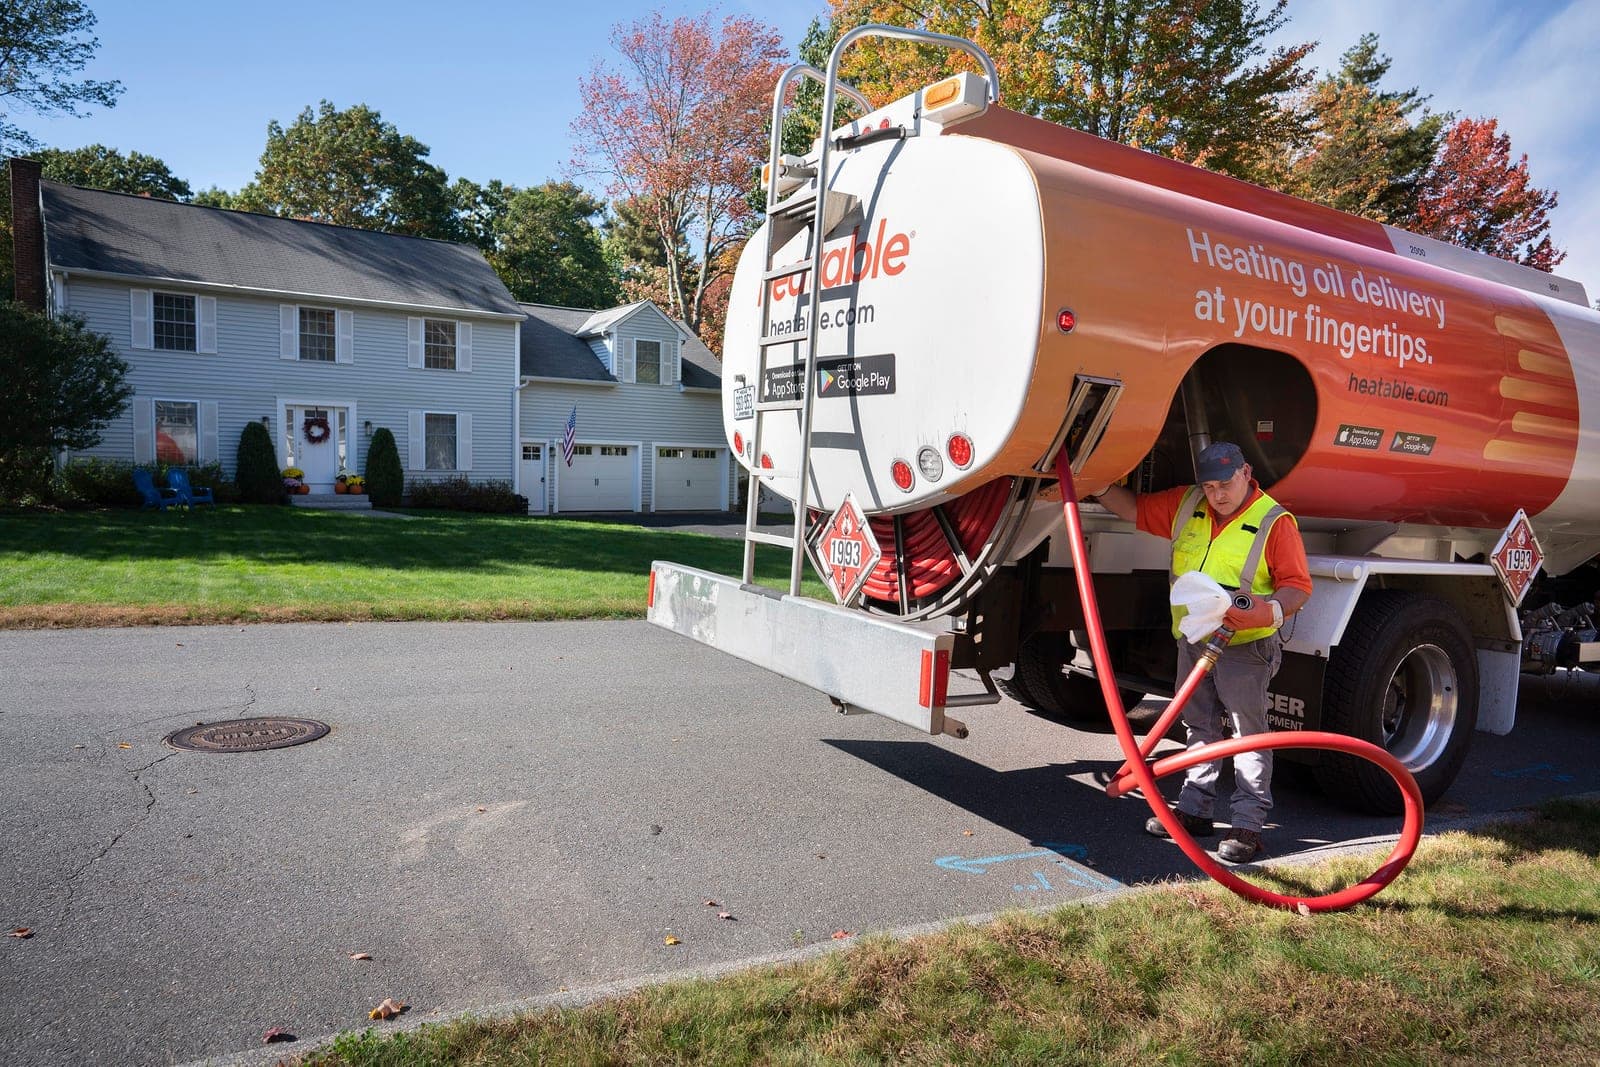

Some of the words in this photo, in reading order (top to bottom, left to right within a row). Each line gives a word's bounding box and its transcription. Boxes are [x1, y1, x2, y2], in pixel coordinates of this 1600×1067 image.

[1409, 245, 1426, 257] 2000
[757, 218, 910, 307] eaable
[1187, 228, 1307, 297] Heating
[1313, 263, 1345, 298] oil
[1351, 270, 1445, 329] delivery
[769, 303, 876, 337] heatae.com
[1195, 287, 1225, 324] at
[1233, 296, 1298, 338] your
[1304, 305, 1433, 368] fingertips.
[771, 370, 791, 380] Download
[853, 362, 862, 370] ON
[772, 382, 786, 399] App
[786, 379, 806, 395] Store
[837, 374, 869, 391] Google
[870, 371, 891, 389] Play
[1348, 372, 1449, 408] heatable.com
[1348, 435, 1361, 446] App
[1360, 436, 1378, 447] Store
[1403, 441, 1421, 452] Google
[1420, 445, 1432, 454] Play
[831, 541, 861, 567] 1993
[1507, 550, 1531, 569] 1993
[1265, 692, 1304, 717] SER
